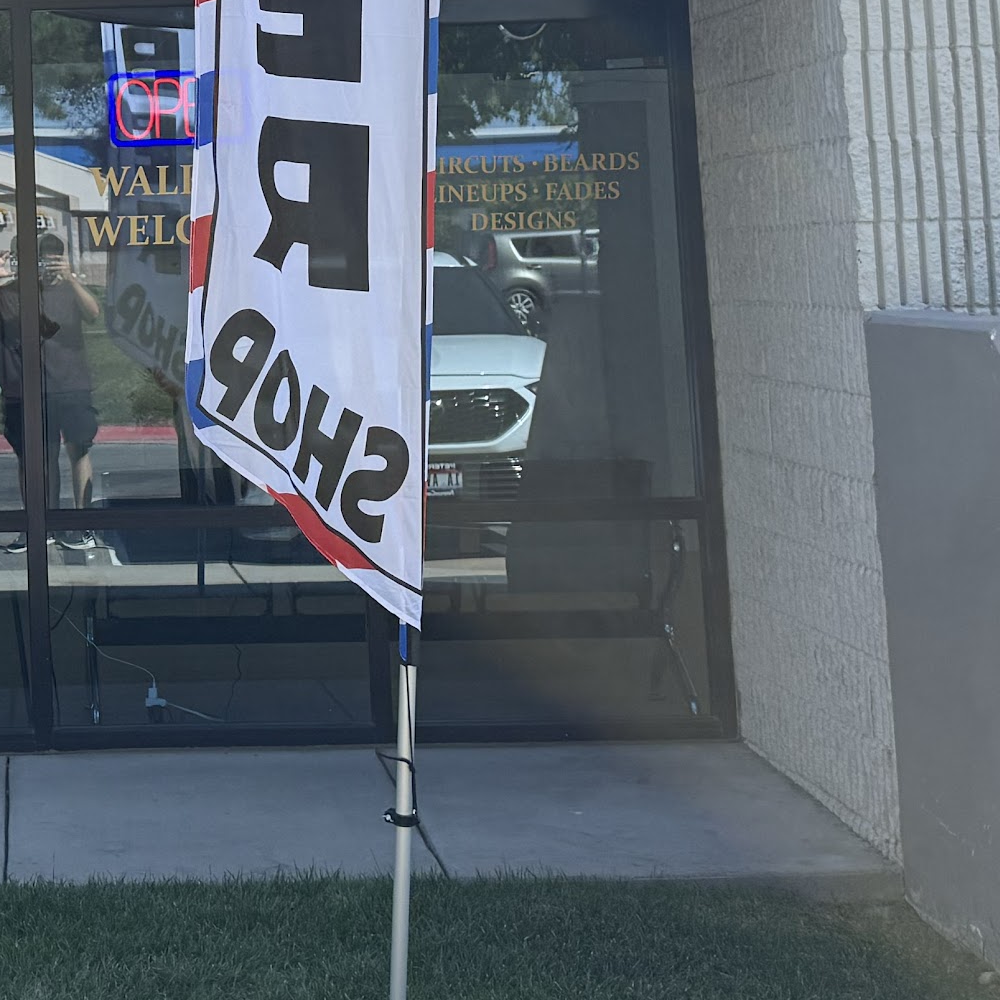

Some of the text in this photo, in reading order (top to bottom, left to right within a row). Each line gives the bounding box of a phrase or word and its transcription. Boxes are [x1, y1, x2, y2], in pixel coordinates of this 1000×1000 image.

[115, 78, 196, 140] OPE
[438, 151, 640, 175] IRCUTS BEARDS
[434, 181, 620, 204] INEUPS FADES
[84, 214, 191, 247] WELC
[471, 210, 577, 232] DESIGNS
